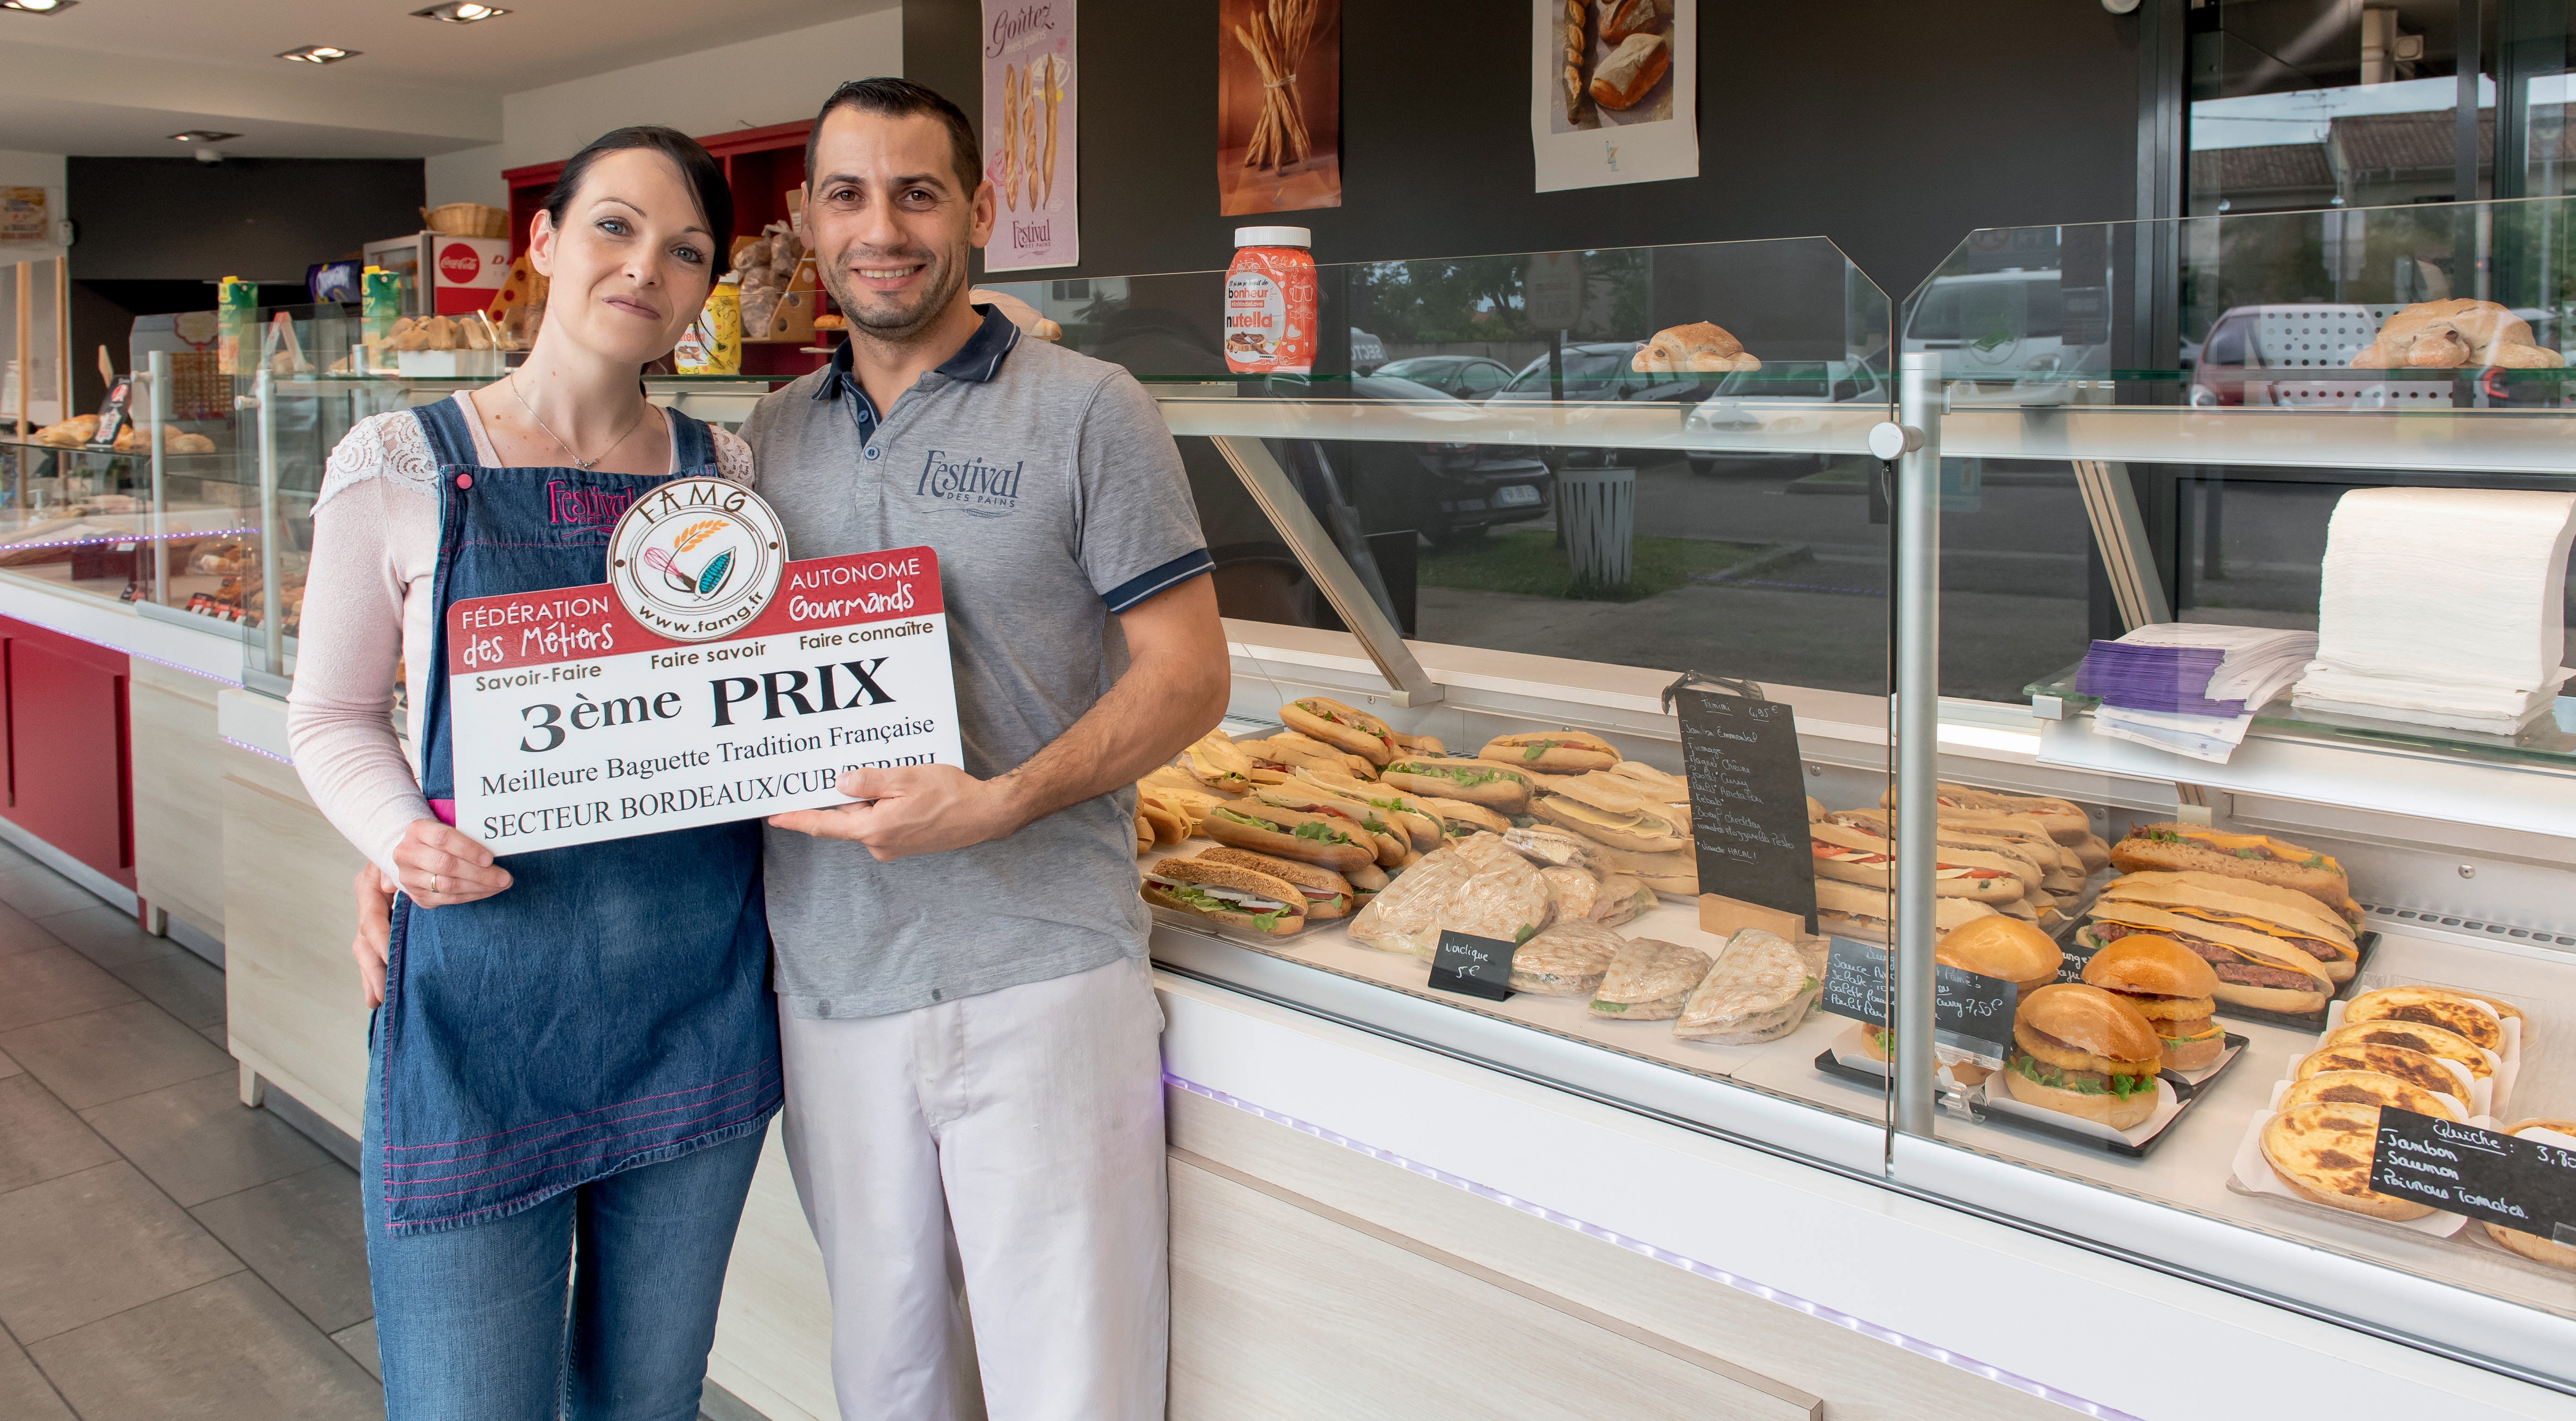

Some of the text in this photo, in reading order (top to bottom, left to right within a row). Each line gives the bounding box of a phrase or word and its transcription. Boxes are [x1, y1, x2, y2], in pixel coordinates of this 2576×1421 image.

[986, 3, 1054, 58] Goûtez
[1023, 31, 1046, 50] pains
[1012, 219, 1051, 249] Festival
[1229, 288, 1269, 298] bonheur
[1227, 311, 1272, 327] nutella
[915, 450, 1024, 498] Festival
[547, 480, 633, 523] Festival
[638, 483, 747, 525] FAMG
[947, 492, 1015, 508] DES PAINS
[581, 516, 600, 525] DES
[463, 558, 921, 630] FÉDÉRATION AUTONOME
[464, 580, 915, 668] des Métiers Gourmands
[639, 591, 764, 633] www.famg.fr
[799, 621, 934, 650] Faire connaître
[651, 641, 766, 670] Faire savoir
[476, 664, 601, 692] Savoir-Faire
[519, 656, 897, 753] 3ème PRIX
[480, 716, 935, 797] Meilleure Baguette Tradition Française
[483, 801, 614, 840] SECTEUR
[1771, 833, 1794, 849] Pesto
[1445, 937, 1488, 962] Nordique
[1833, 953, 1872, 977] Sauce
[1829, 980, 1863, 998] Galette
[1831, 993, 1863, 1012] Poulet
[1832, 970, 1867, 987] Salade
[1936, 997, 1963, 1018] Curry
[2381, 1128, 2458, 1162] Jambon
[2433, 1118, 2501, 1149] Quiche
[2388, 1150, 2460, 1181] Saumon
